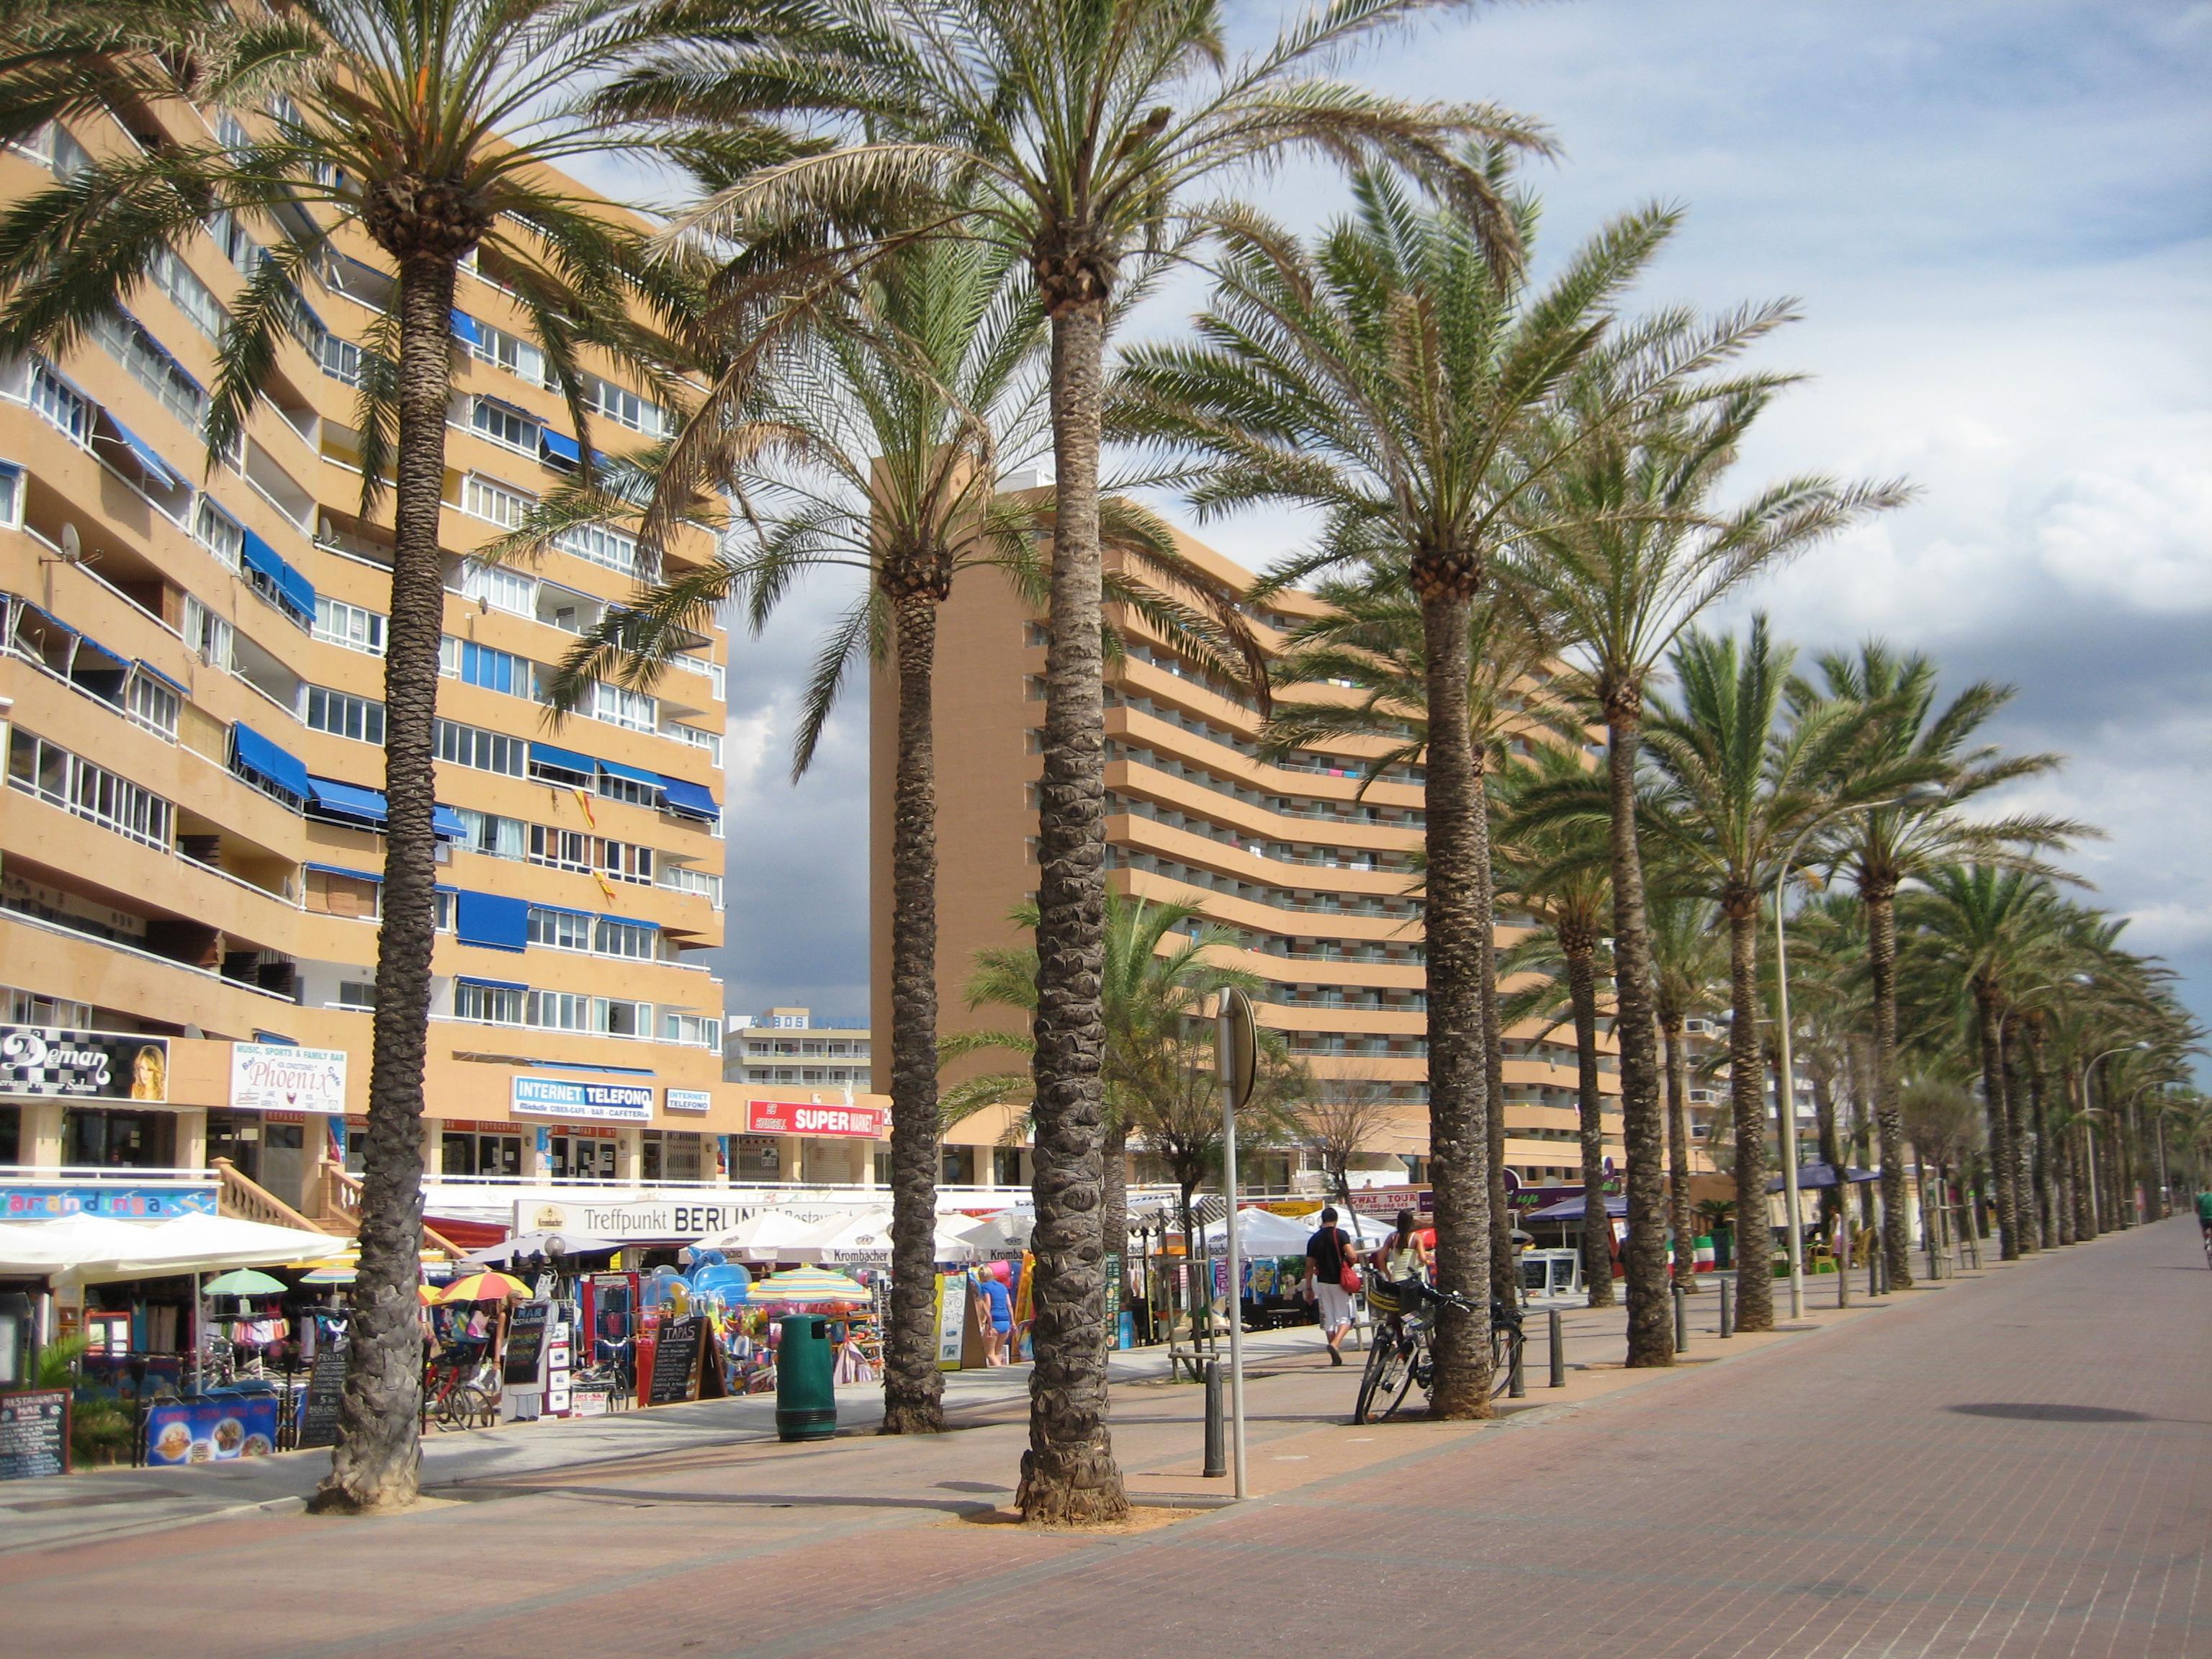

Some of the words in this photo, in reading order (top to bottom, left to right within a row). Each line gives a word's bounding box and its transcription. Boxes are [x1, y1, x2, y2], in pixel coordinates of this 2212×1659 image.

[236, 1045, 263, 1056] MUSIC,
[265, 1047, 293, 1057] SPORTS
[303, 1051, 328, 1060] FAMILY
[330, 1053, 345, 1062] BAR
[241, 1056, 256, 1070] Bar
[248, 1058, 331, 1098] Phoenix
[518, 1081, 583, 1102] INTERNET
[586, 1087, 651, 1105] TELEFONO
[669, 1092, 708, 1101] INTERNET
[669, 1100, 709, 1109] TELEFONO
[608, 1110, 649, 1118] CAFETERIA
[795, 1108, 850, 1131] SUPER
[850, 1112, 873, 1133] MARKET
[480, 1122, 521, 1132] FOTOCOPIAS
[0, 1190, 161, 1215] arandinga
[1337, 1195, 1378, 1205] SGWAY
[1387, 1194, 1418, 1202] TOUR
[1268, 1203, 1301, 1213] Souvenirs
[584, 1208, 667, 1235] Treffpunkt
[834, 1249, 889, 1262] Krombacher
[663, 1325, 696, 1340] TAPAS
